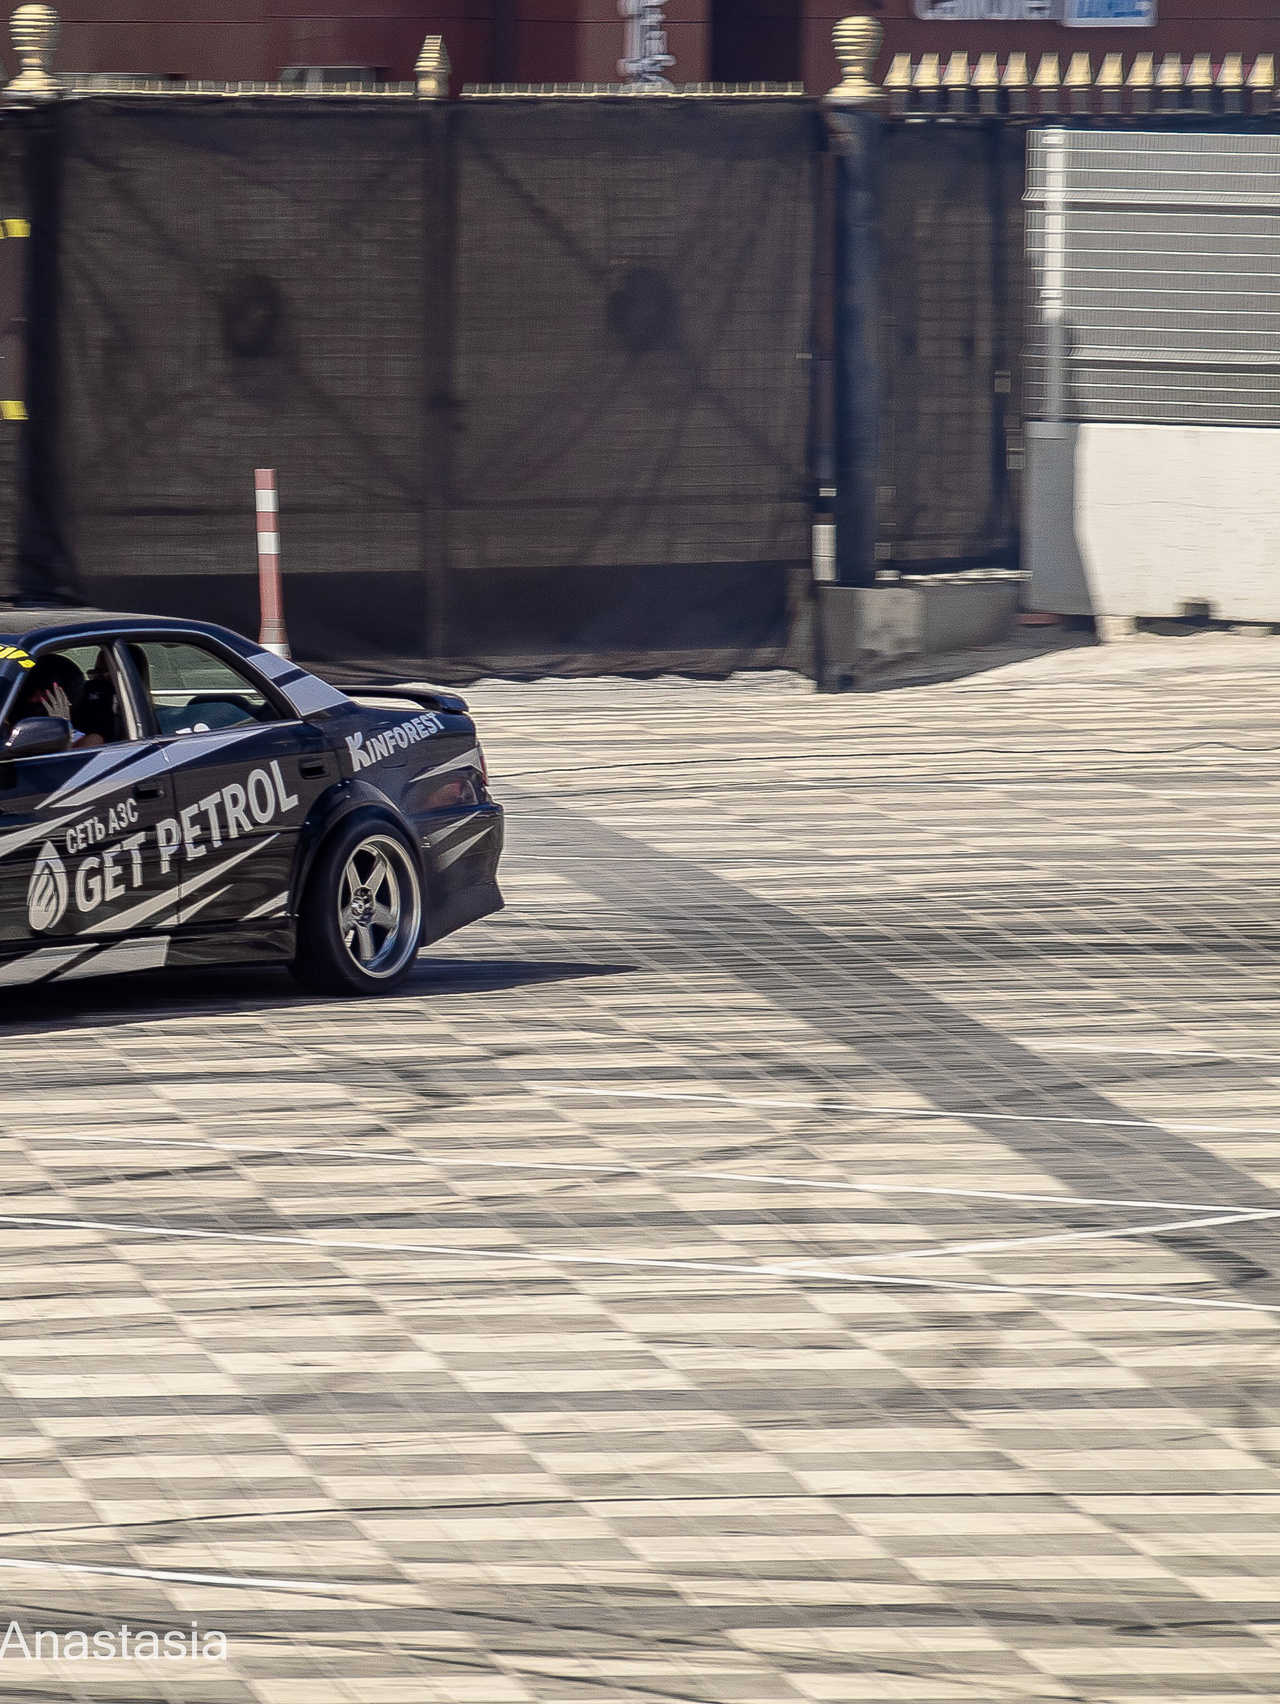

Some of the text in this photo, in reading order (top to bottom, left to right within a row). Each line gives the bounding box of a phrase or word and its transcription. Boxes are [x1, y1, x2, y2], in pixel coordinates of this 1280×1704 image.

[345, 711, 445, 772] KINFOREST
[65, 798, 139, 854] СЕТЬ АЗС
[75, 760, 299, 913] GET PETROL
